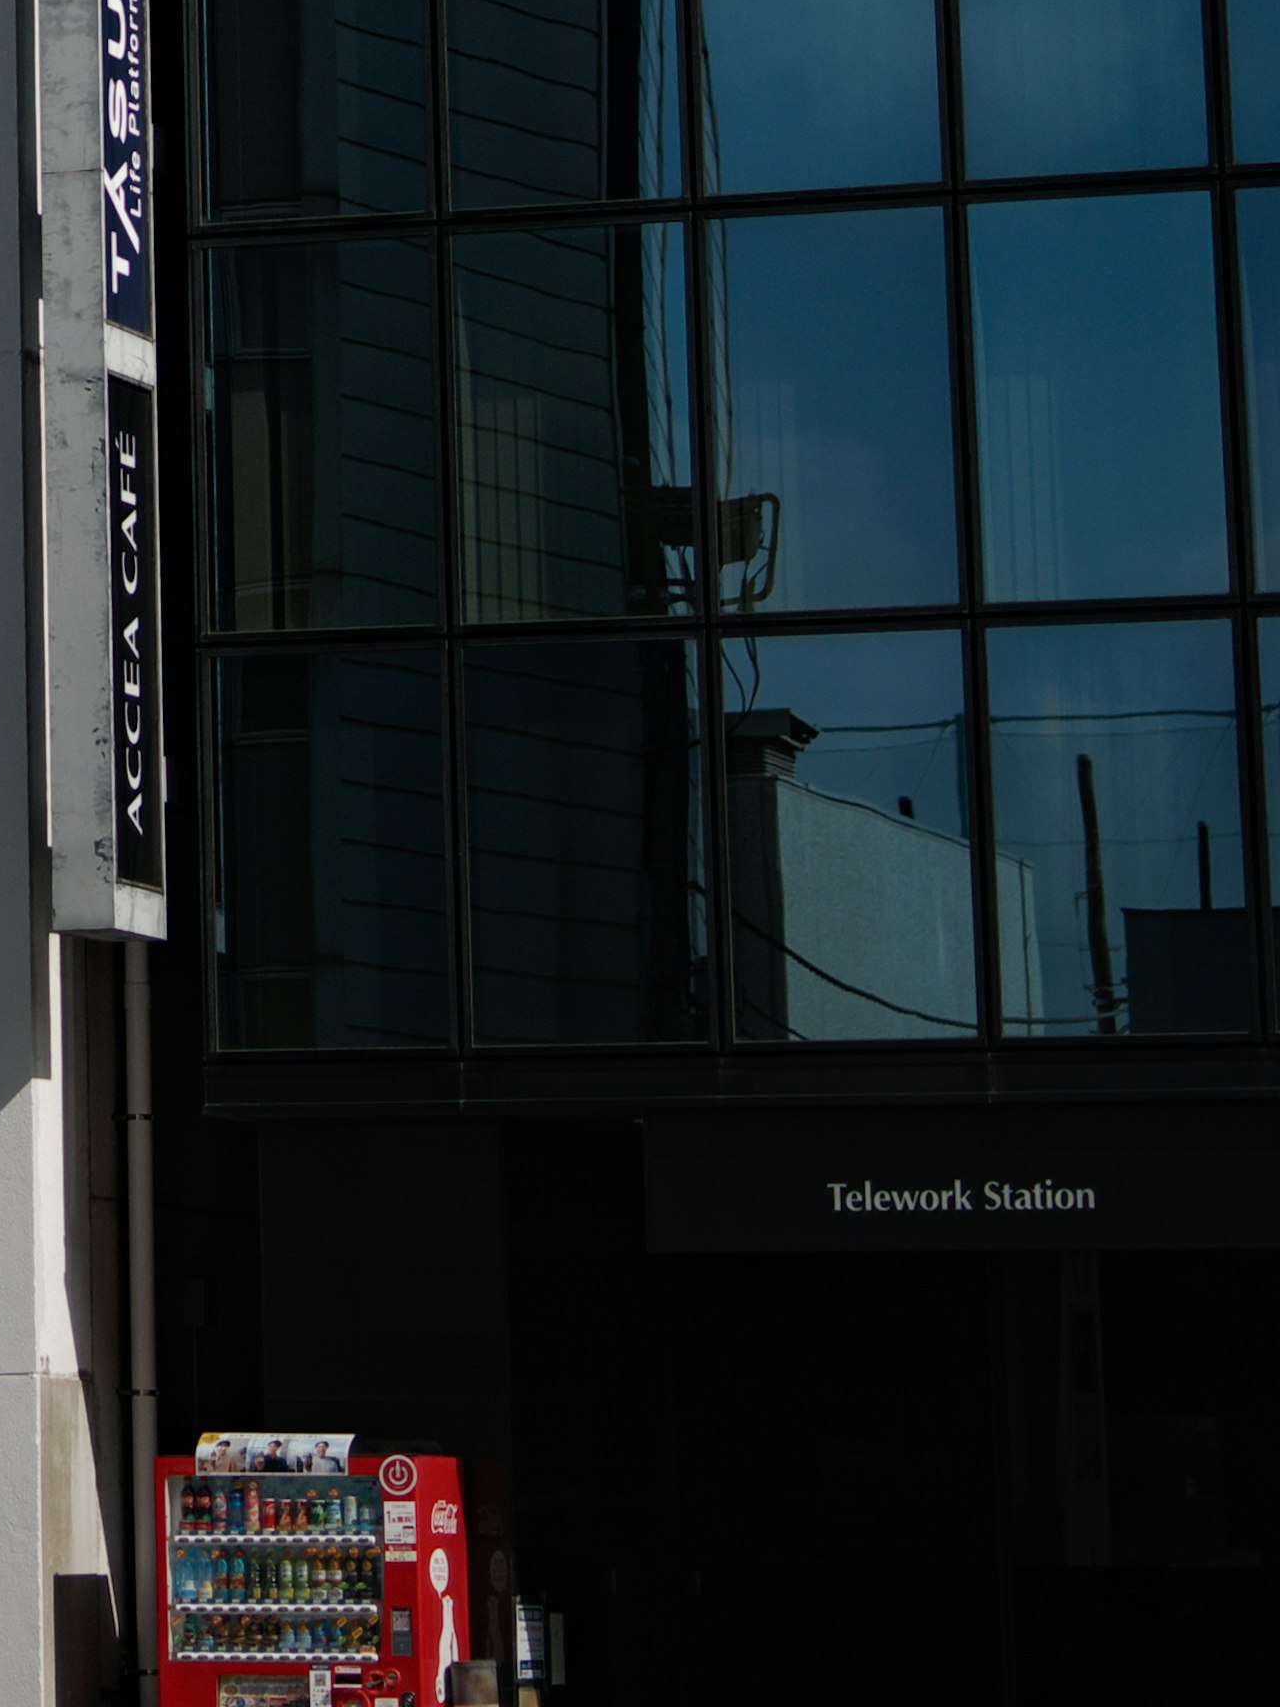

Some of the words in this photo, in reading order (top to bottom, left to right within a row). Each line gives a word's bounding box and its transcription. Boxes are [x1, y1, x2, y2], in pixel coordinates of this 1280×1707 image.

[129, 149, 143, 219] Life
[114, 430, 139, 595] CAFÉ
[122, 615, 143, 836] ACCEA
[827, 1179, 973, 1211] Telework
[983, 1179, 1096, 1211] Station
